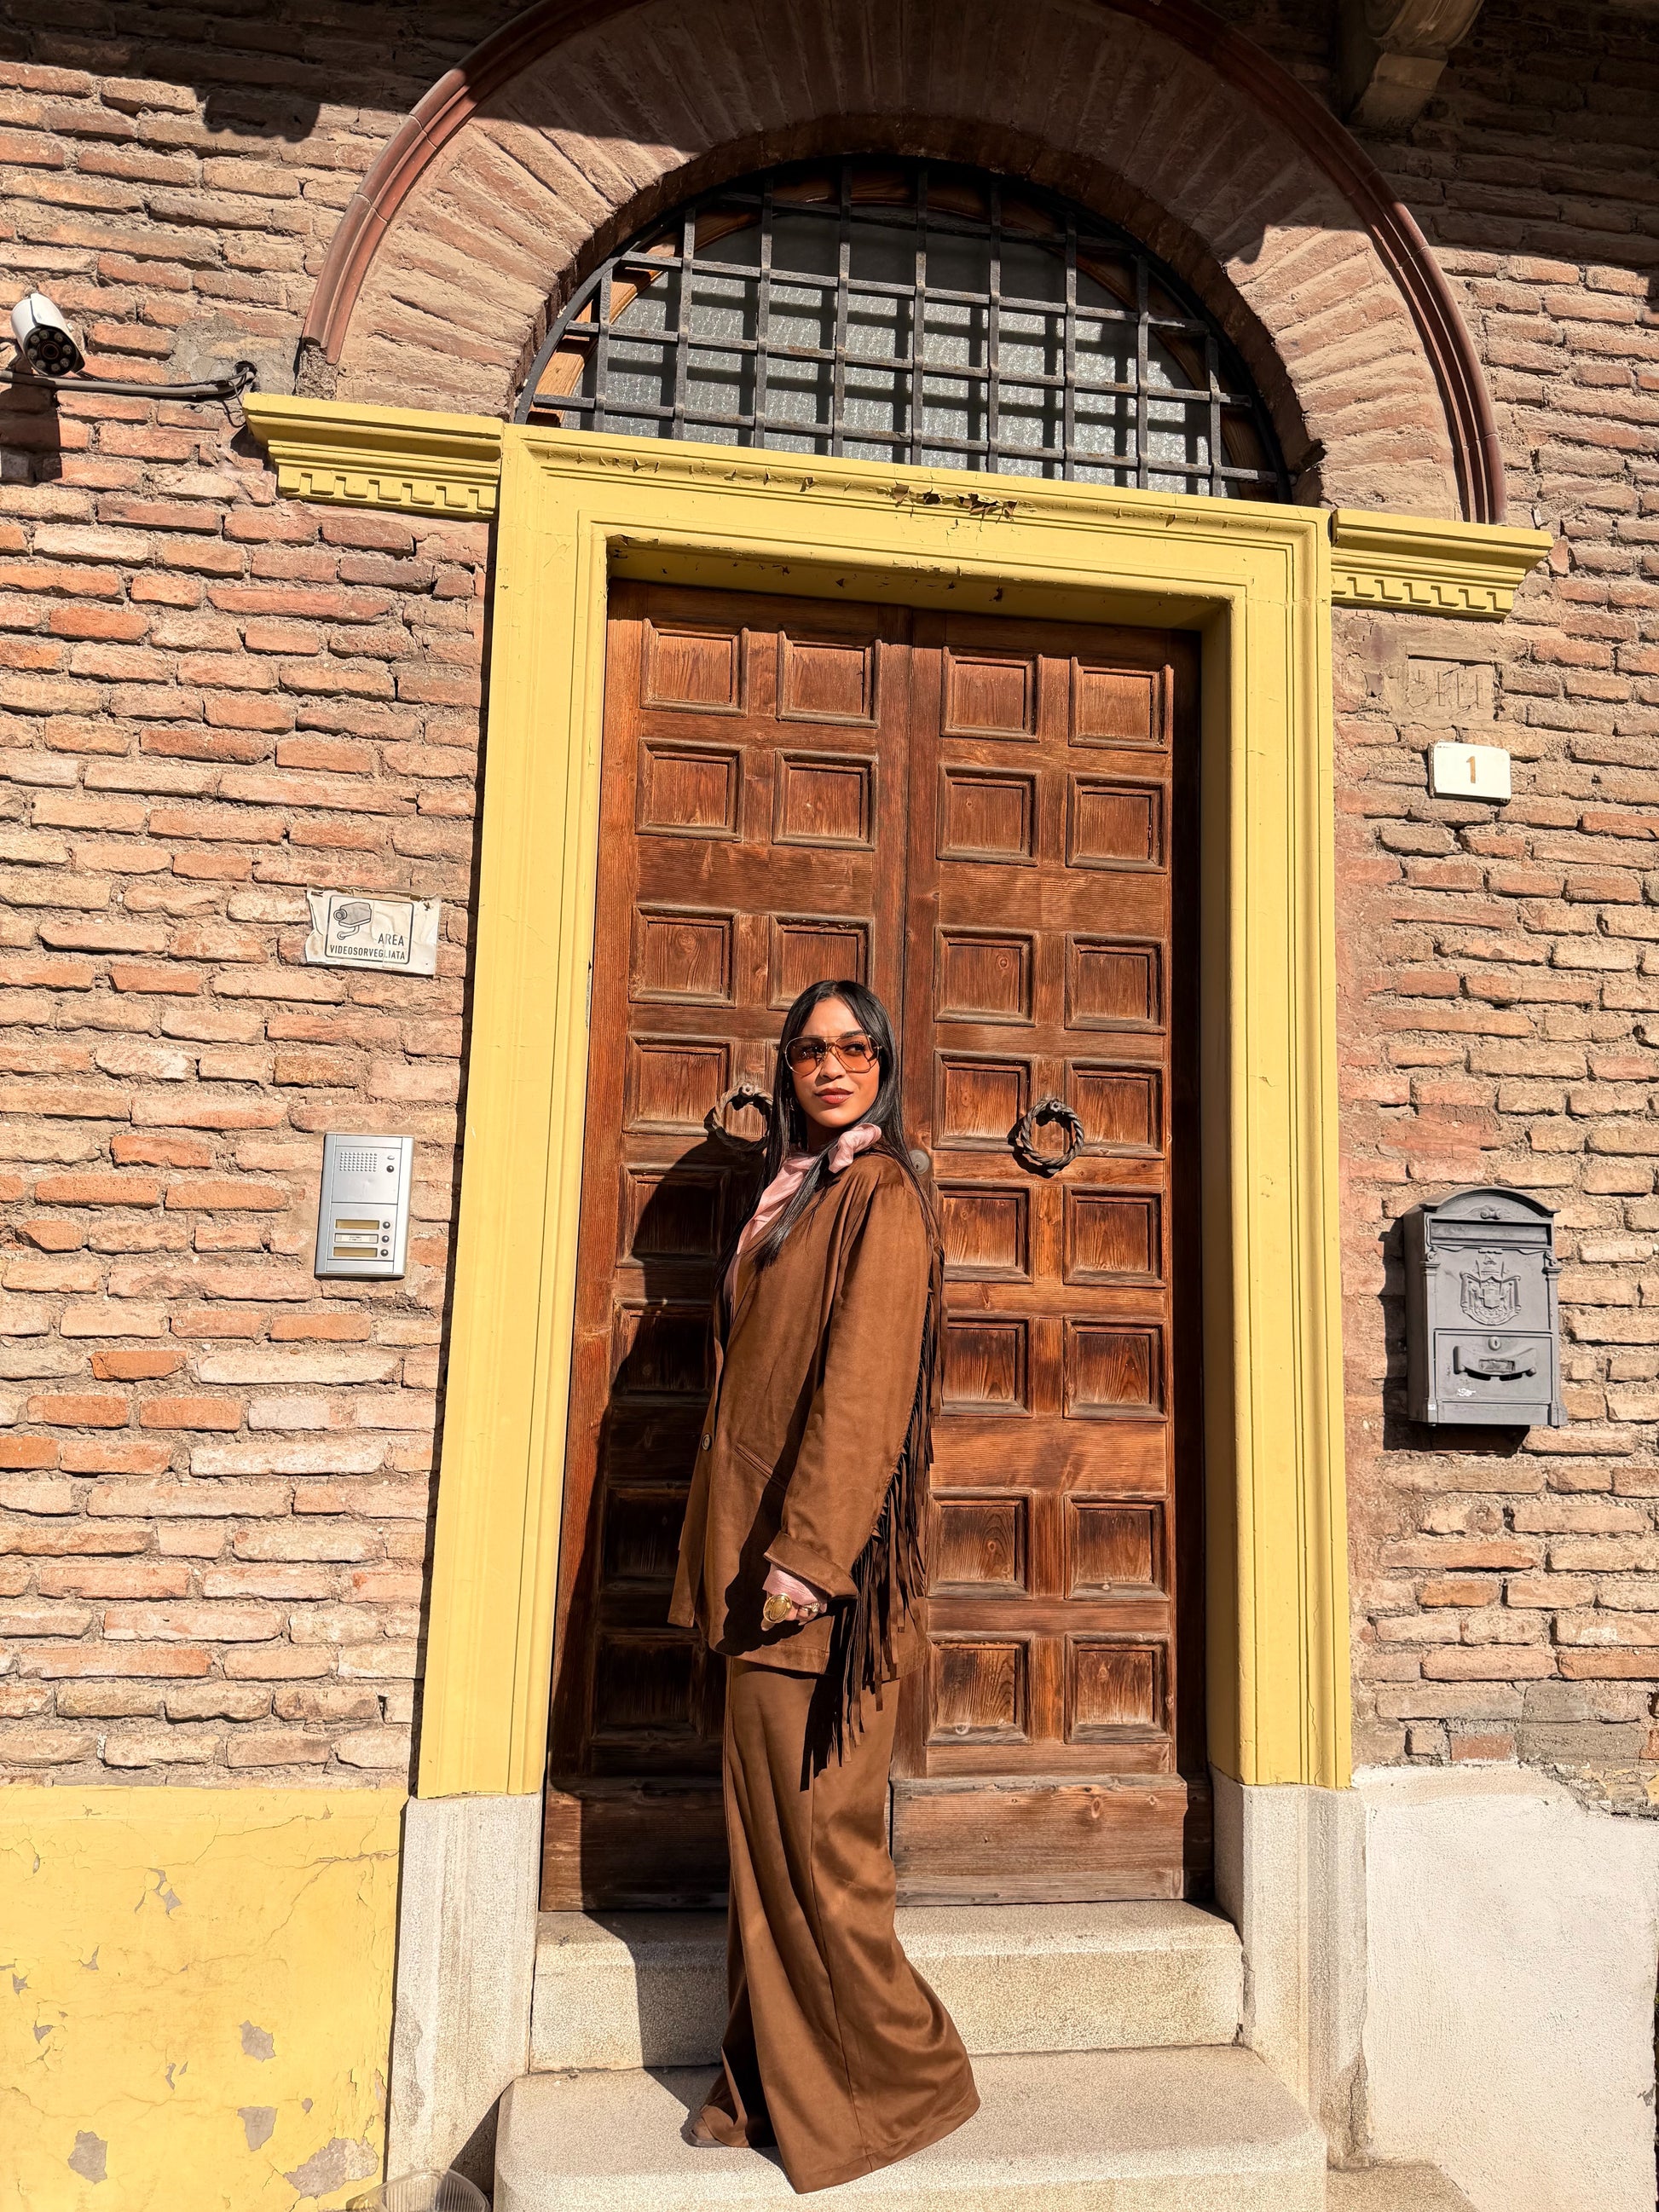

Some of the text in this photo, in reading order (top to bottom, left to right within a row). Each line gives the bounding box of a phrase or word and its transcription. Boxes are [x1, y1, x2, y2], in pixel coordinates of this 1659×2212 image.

[1466, 756, 1476, 783] 1
[378, 933, 404, 946] AREA
[330, 944, 405, 960] VIDEOSORVEGLIATA
